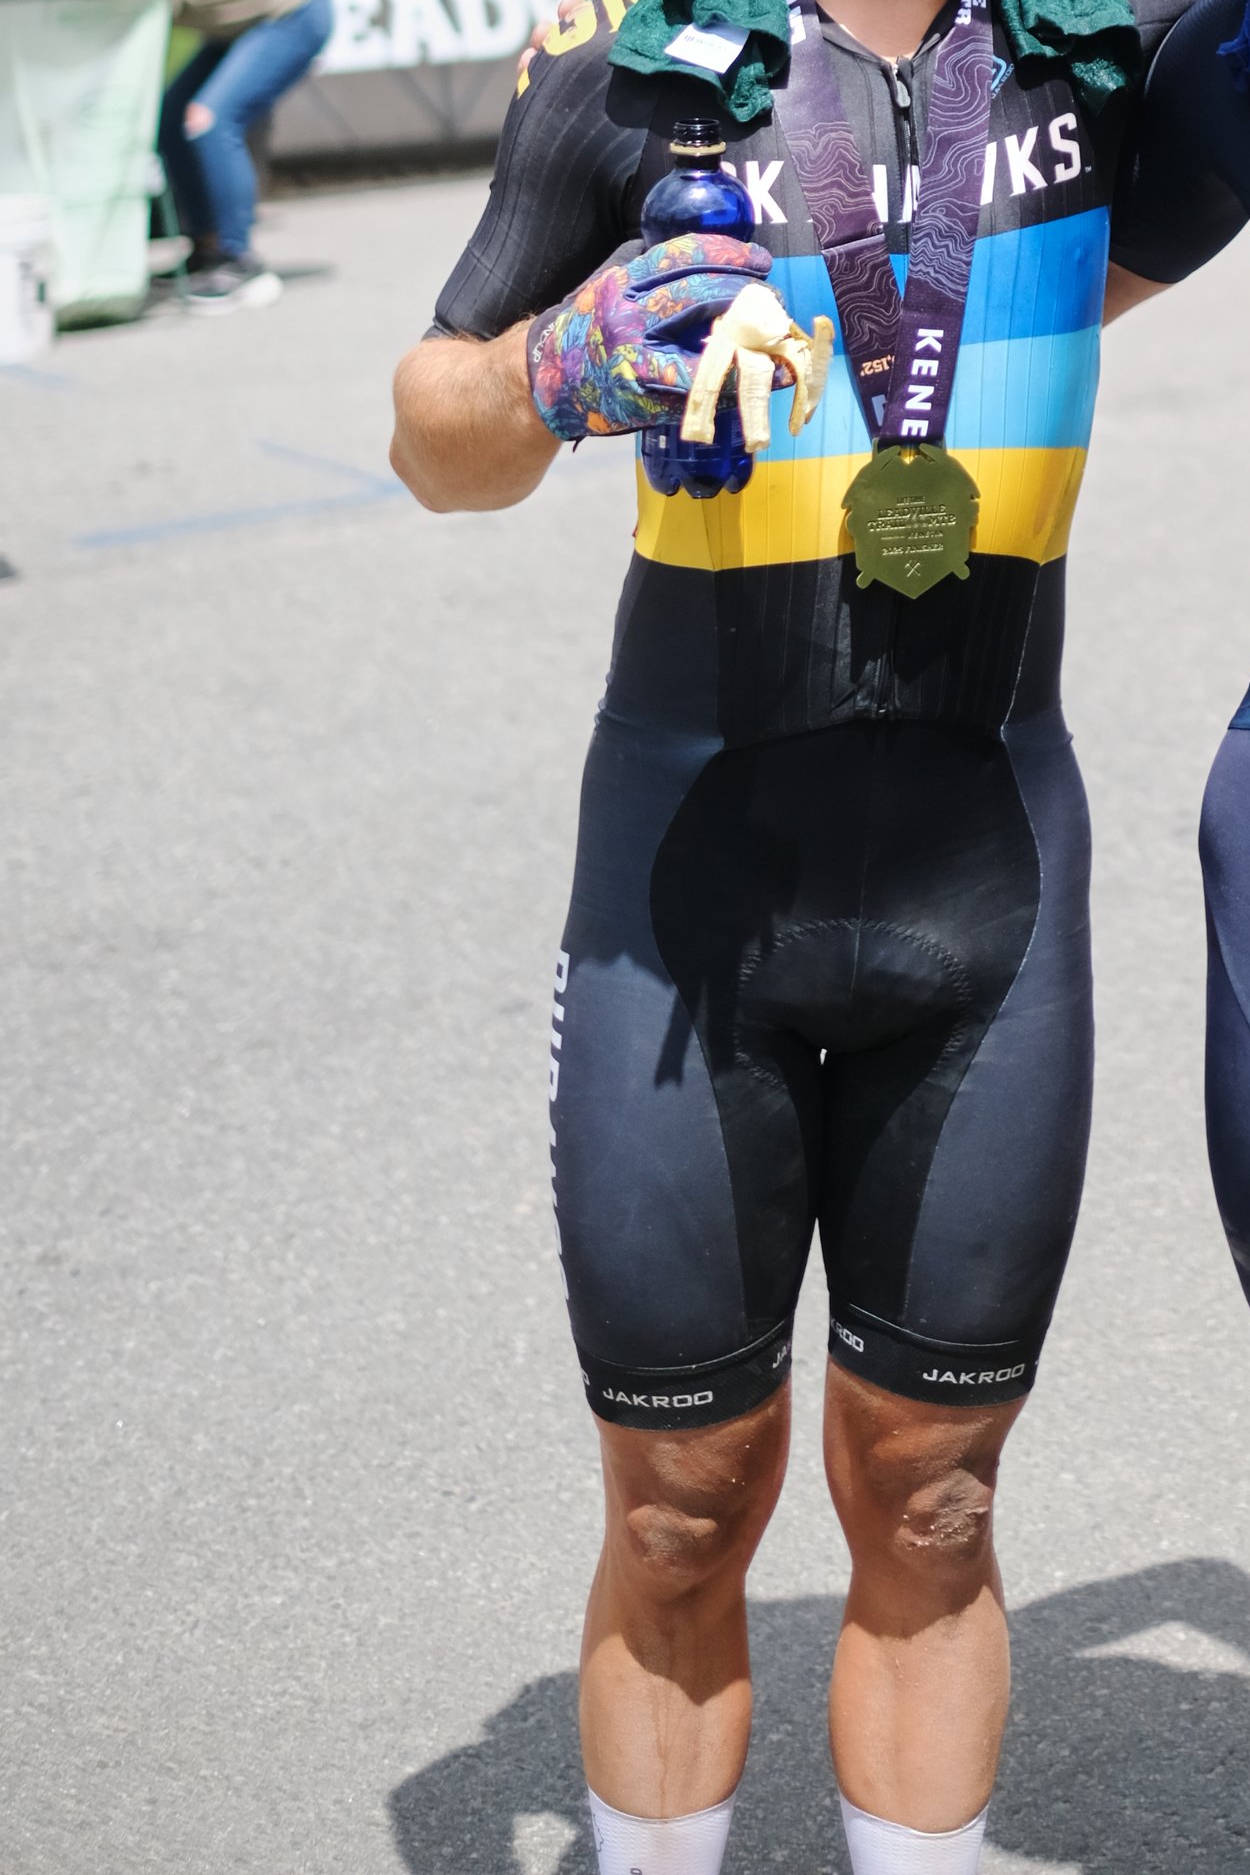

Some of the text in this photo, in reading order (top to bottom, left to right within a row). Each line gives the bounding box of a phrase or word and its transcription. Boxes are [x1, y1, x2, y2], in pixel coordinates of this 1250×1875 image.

[901, 328, 944, 437] KENE
[922, 1363, 1025, 1385] JAKROO
[602, 1387, 714, 1408] JAKROO
